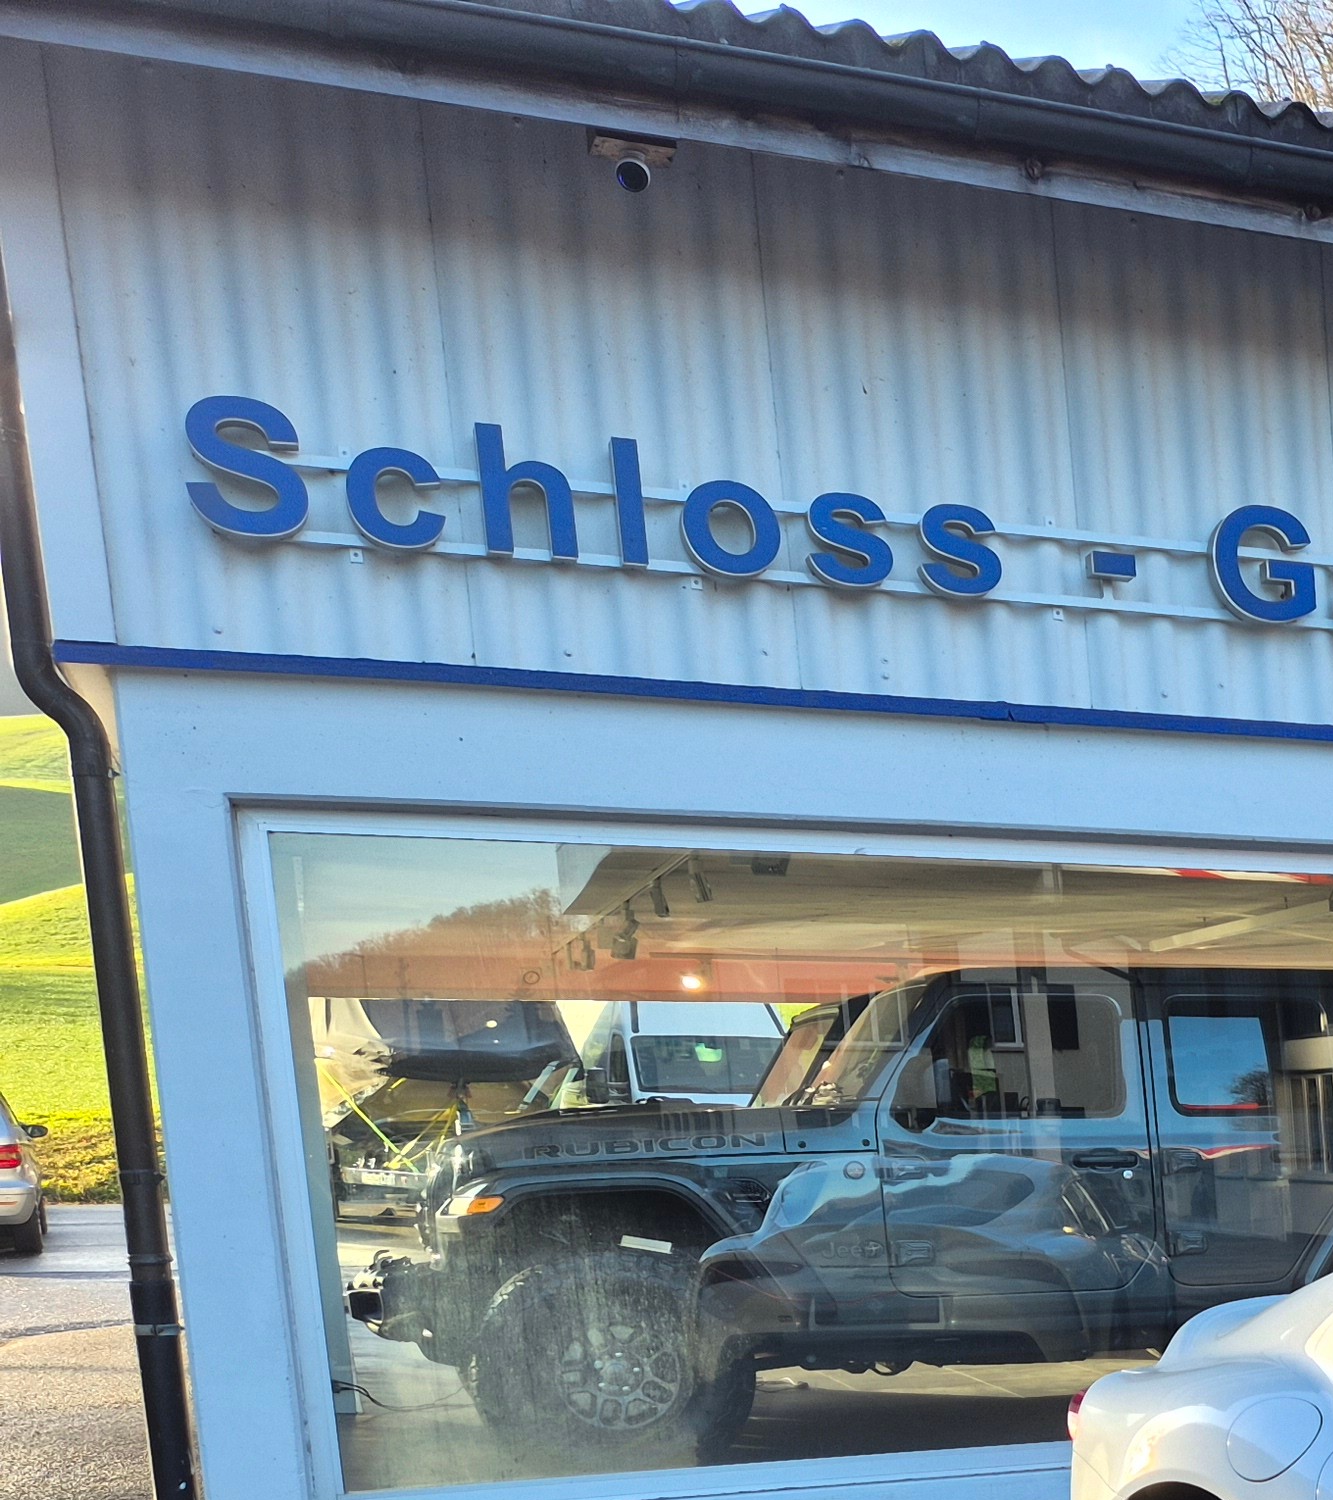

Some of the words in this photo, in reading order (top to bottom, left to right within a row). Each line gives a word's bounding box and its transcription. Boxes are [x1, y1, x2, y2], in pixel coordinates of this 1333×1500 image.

[185, 395, 1003, 596] Schloss
[1086, 550, 1137, 582] -
[522, 1132, 768, 1161] RUBICON
